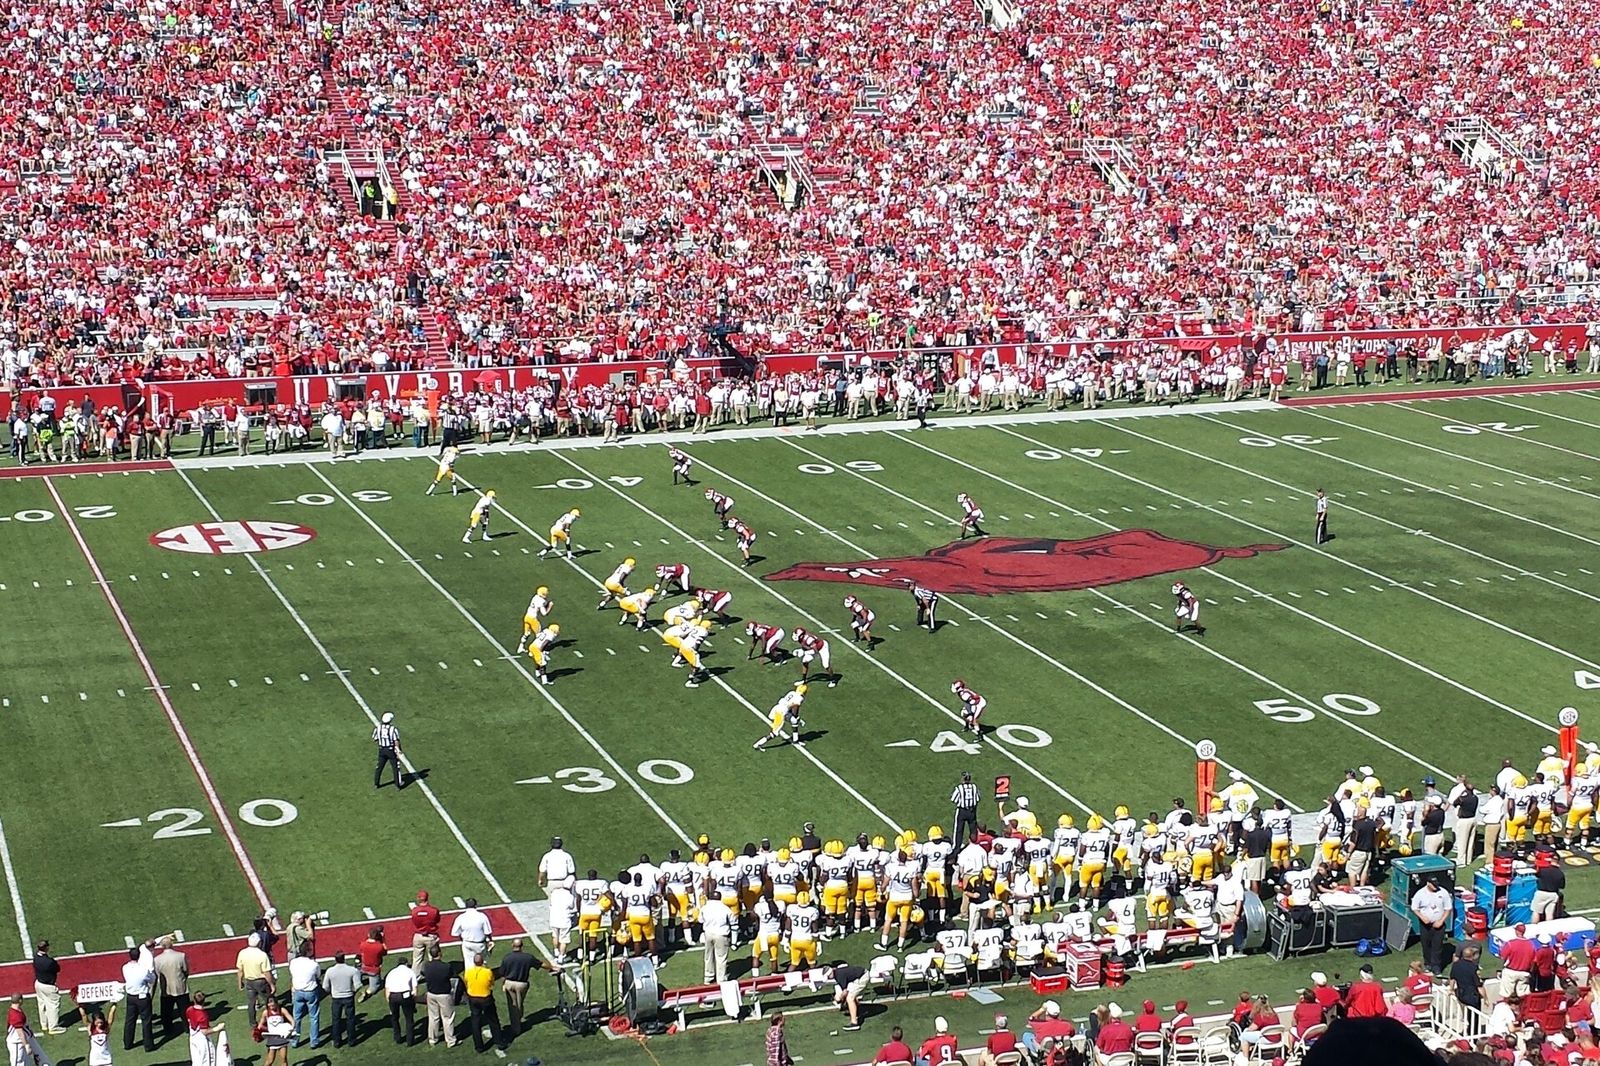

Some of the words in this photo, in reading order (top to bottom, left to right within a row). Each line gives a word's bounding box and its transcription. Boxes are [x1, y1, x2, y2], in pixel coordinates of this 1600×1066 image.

[1253, 693, 1382, 723] 50
[929, 724, 1053, 755] 40
[554, 758, 695, 793] 30
[996, 777, 1010, 794] 2
[146, 798, 299, 840] 20
[1272, 818, 1288, 830] 23
[1089, 840, 1106, 852] 67
[933, 851, 942, 862] 9
[745, 864, 761, 876] 98
[856, 859, 875, 872] 56
[717, 876, 736, 887] 45
[774, 873, 791, 884] 49
[893, 871, 910, 884] 46
[1293, 878, 1311, 890] 20
[582, 888, 600, 901] 85
[1194, 896, 1212, 910] 26
[1123, 903, 1131, 917] 6
[791, 914, 810, 928] 38
[1075, 917, 1085, 929] 5
[944, 935, 963, 949] 37
[1047, 931, 1066, 944] 42
[81, 984, 114, 999] DEFENSE
[941, 1045, 952, 1062] 9
